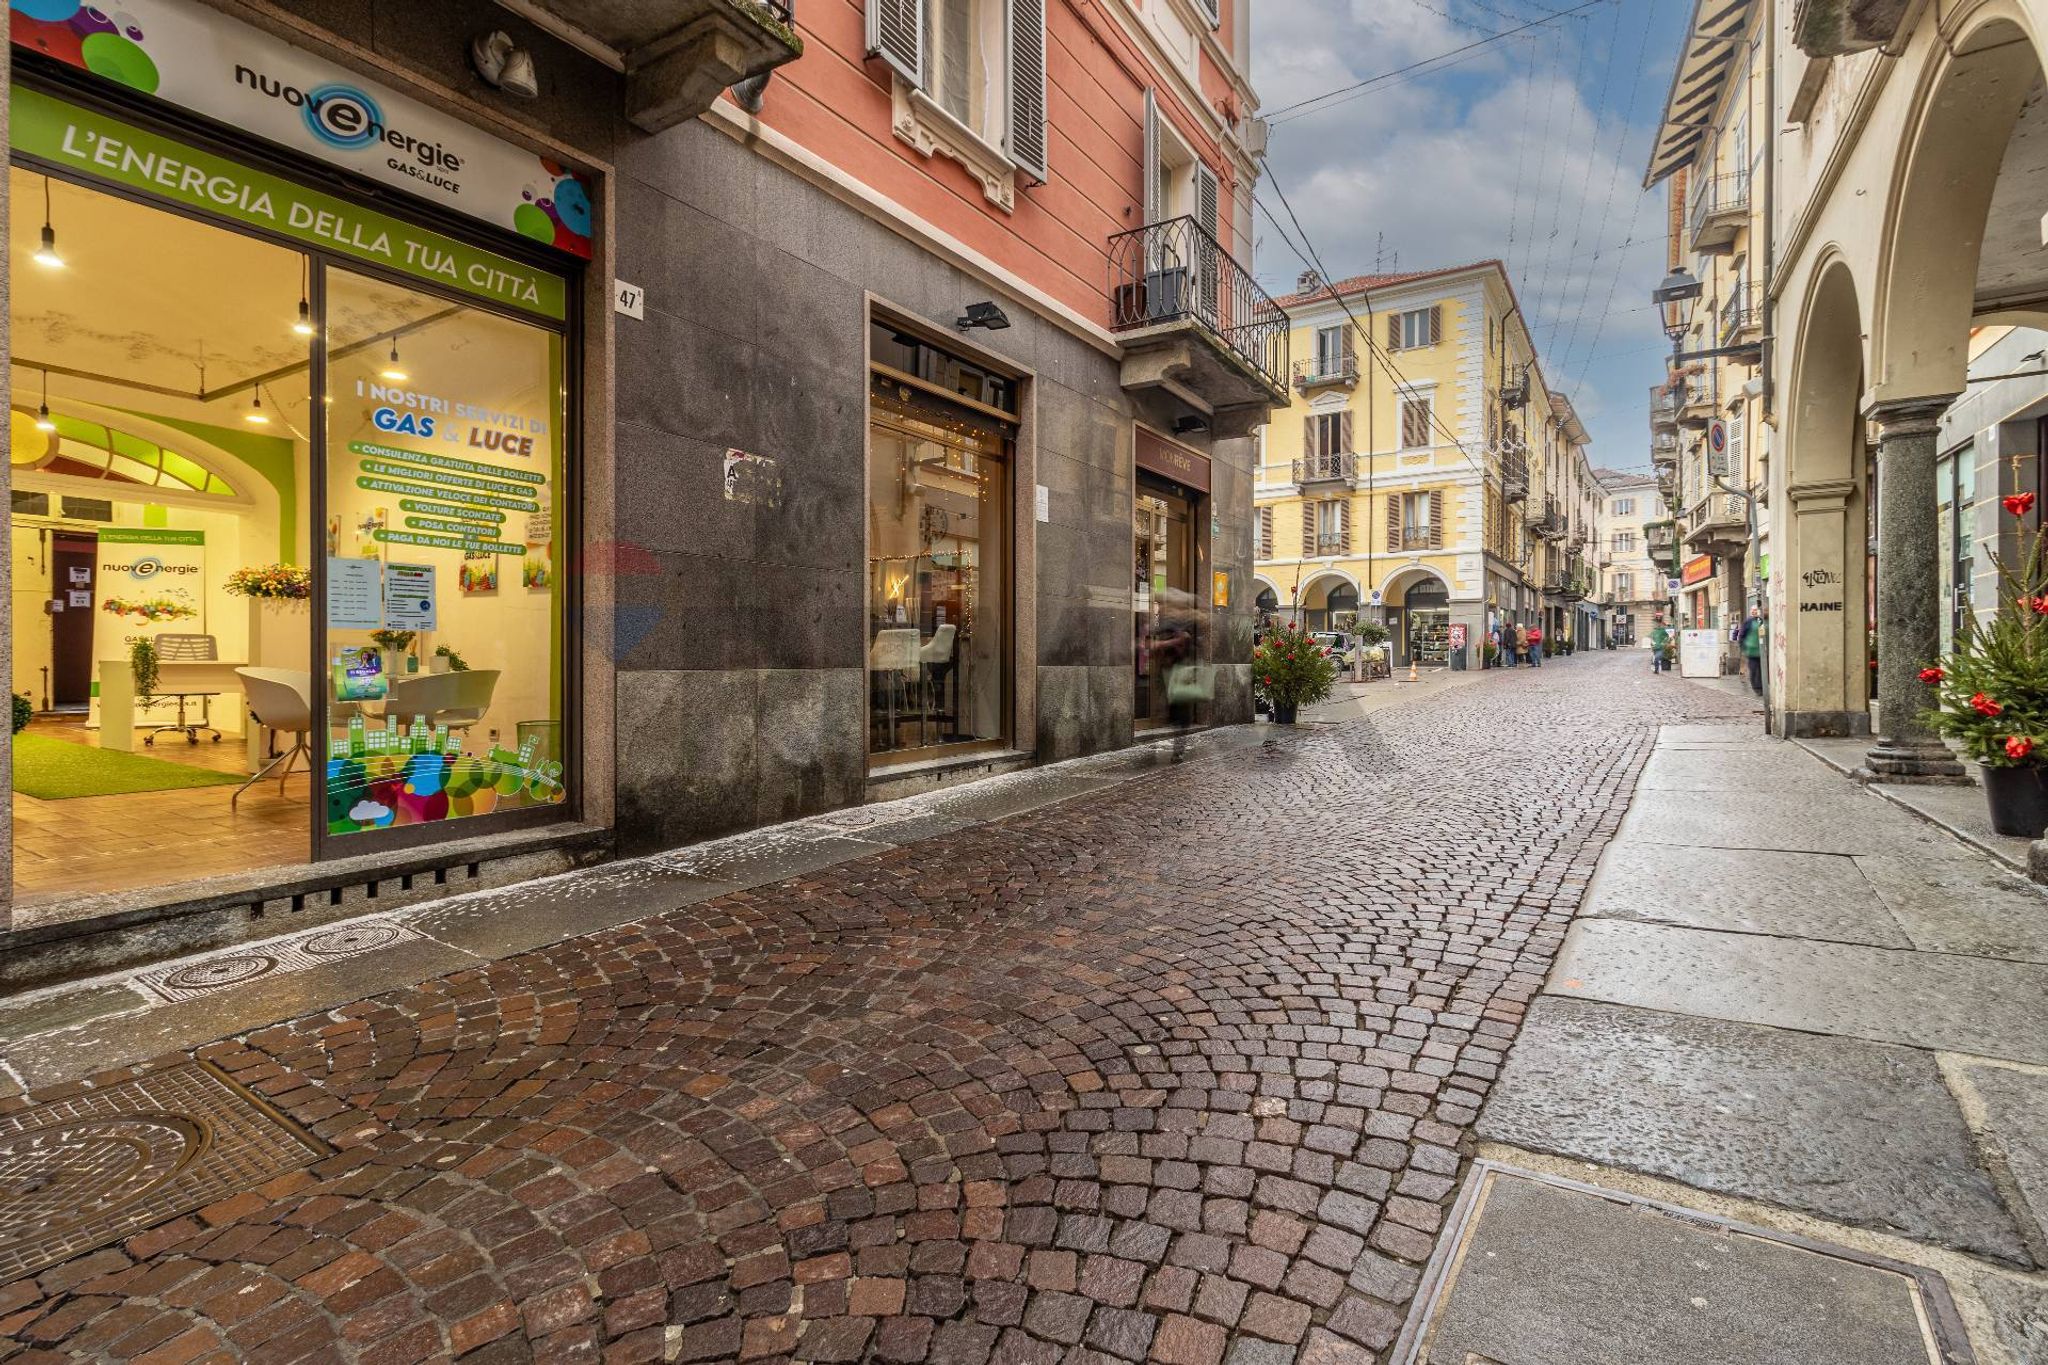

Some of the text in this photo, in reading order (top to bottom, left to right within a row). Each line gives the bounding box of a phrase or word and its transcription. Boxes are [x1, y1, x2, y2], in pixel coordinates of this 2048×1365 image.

[387, 158, 460, 194] GAS&LUCE
[62, 124, 539, 305] L’ENERGIA DELLA TUA CITTÀ
[620, 290, 635, 308] 47
[356, 379, 547, 434] I NOSTRI SERVIZI DI
[374, 407, 534, 457] GAS & LUCE
[362, 444, 543, 483] CONSULENZA GRATUITA DELLE BOLLETTE
[370, 480, 536, 511] ATTIVAZIONE VELOCE DEI CONTATORI
[373, 464, 533, 496] LE MIGLIORI OFFERTE DI LUCE E GAS
[414, 502, 501, 521] VOLTURE SCONTATE
[387, 532, 522, 554] PAGA DA NOI LE TUE BOLLETTE
[418, 519, 496, 536] POSA CONTATORI
[1800, 601, 1842, 612] HAINE
